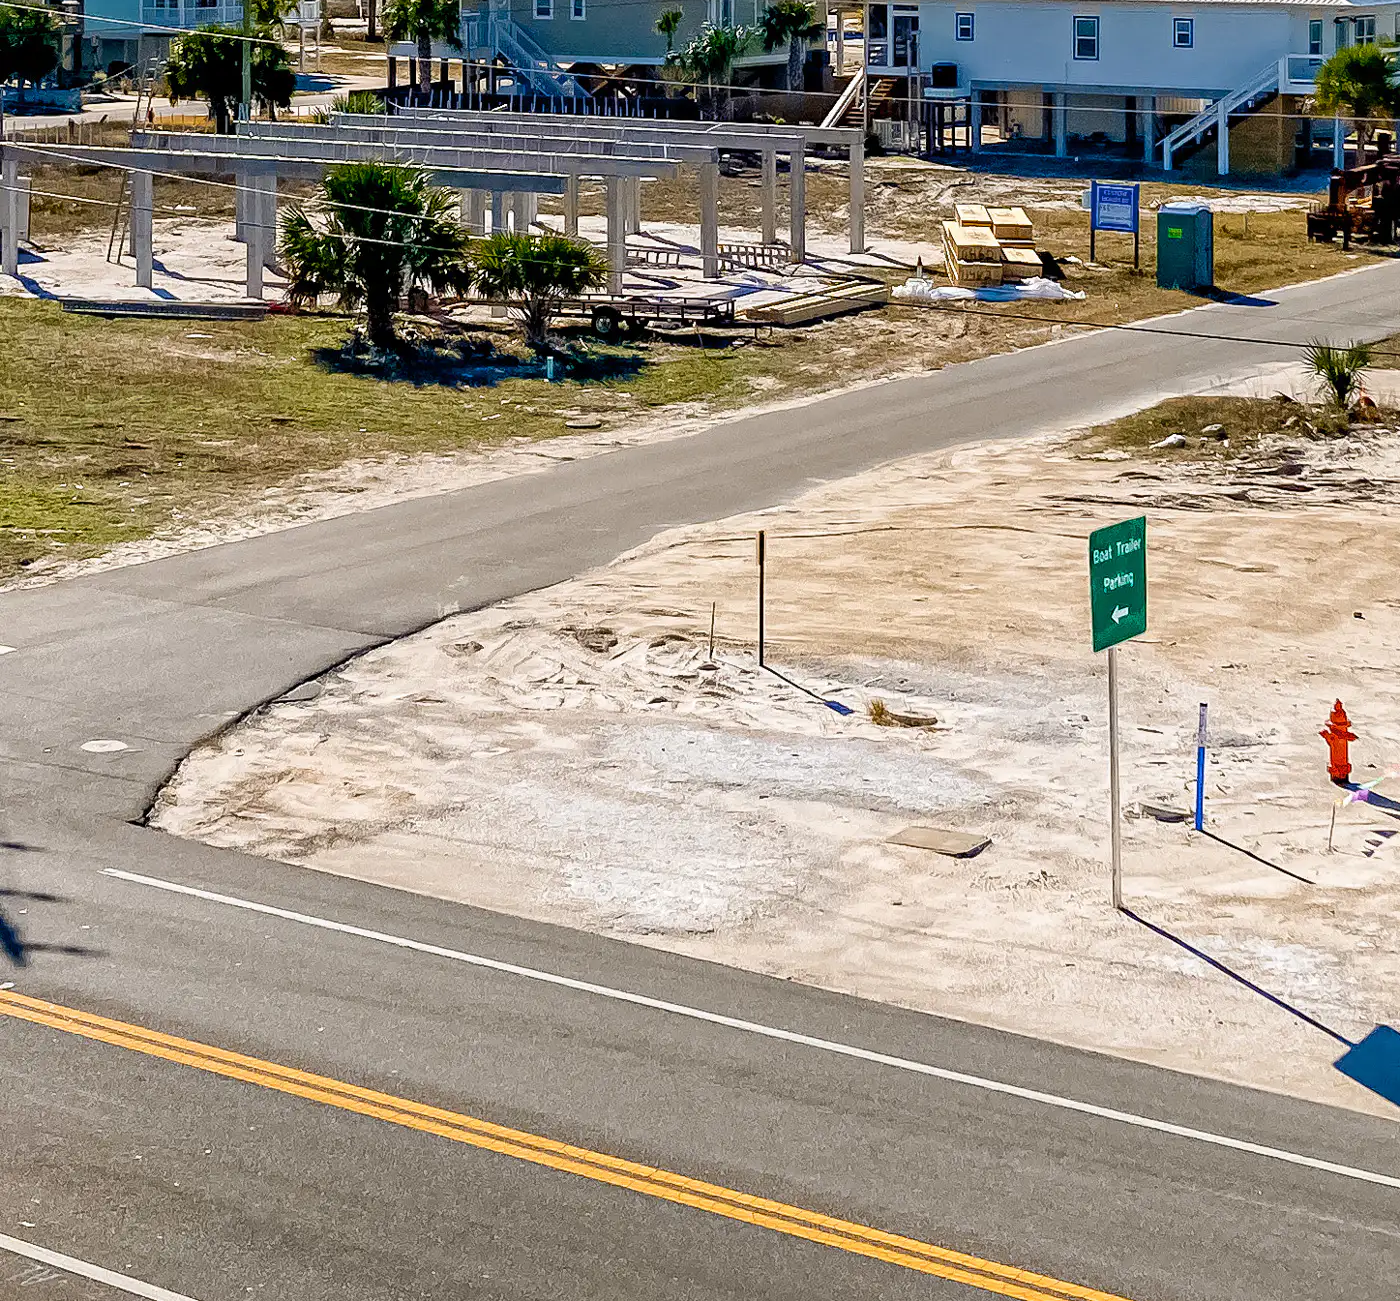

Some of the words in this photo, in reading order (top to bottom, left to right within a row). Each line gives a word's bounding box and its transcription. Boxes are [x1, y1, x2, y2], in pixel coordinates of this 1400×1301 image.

[1093, 545, 1112, 565] Boat
[1116, 537, 1141, 557] Trailer
[1103, 572, 1134, 594] Parking
